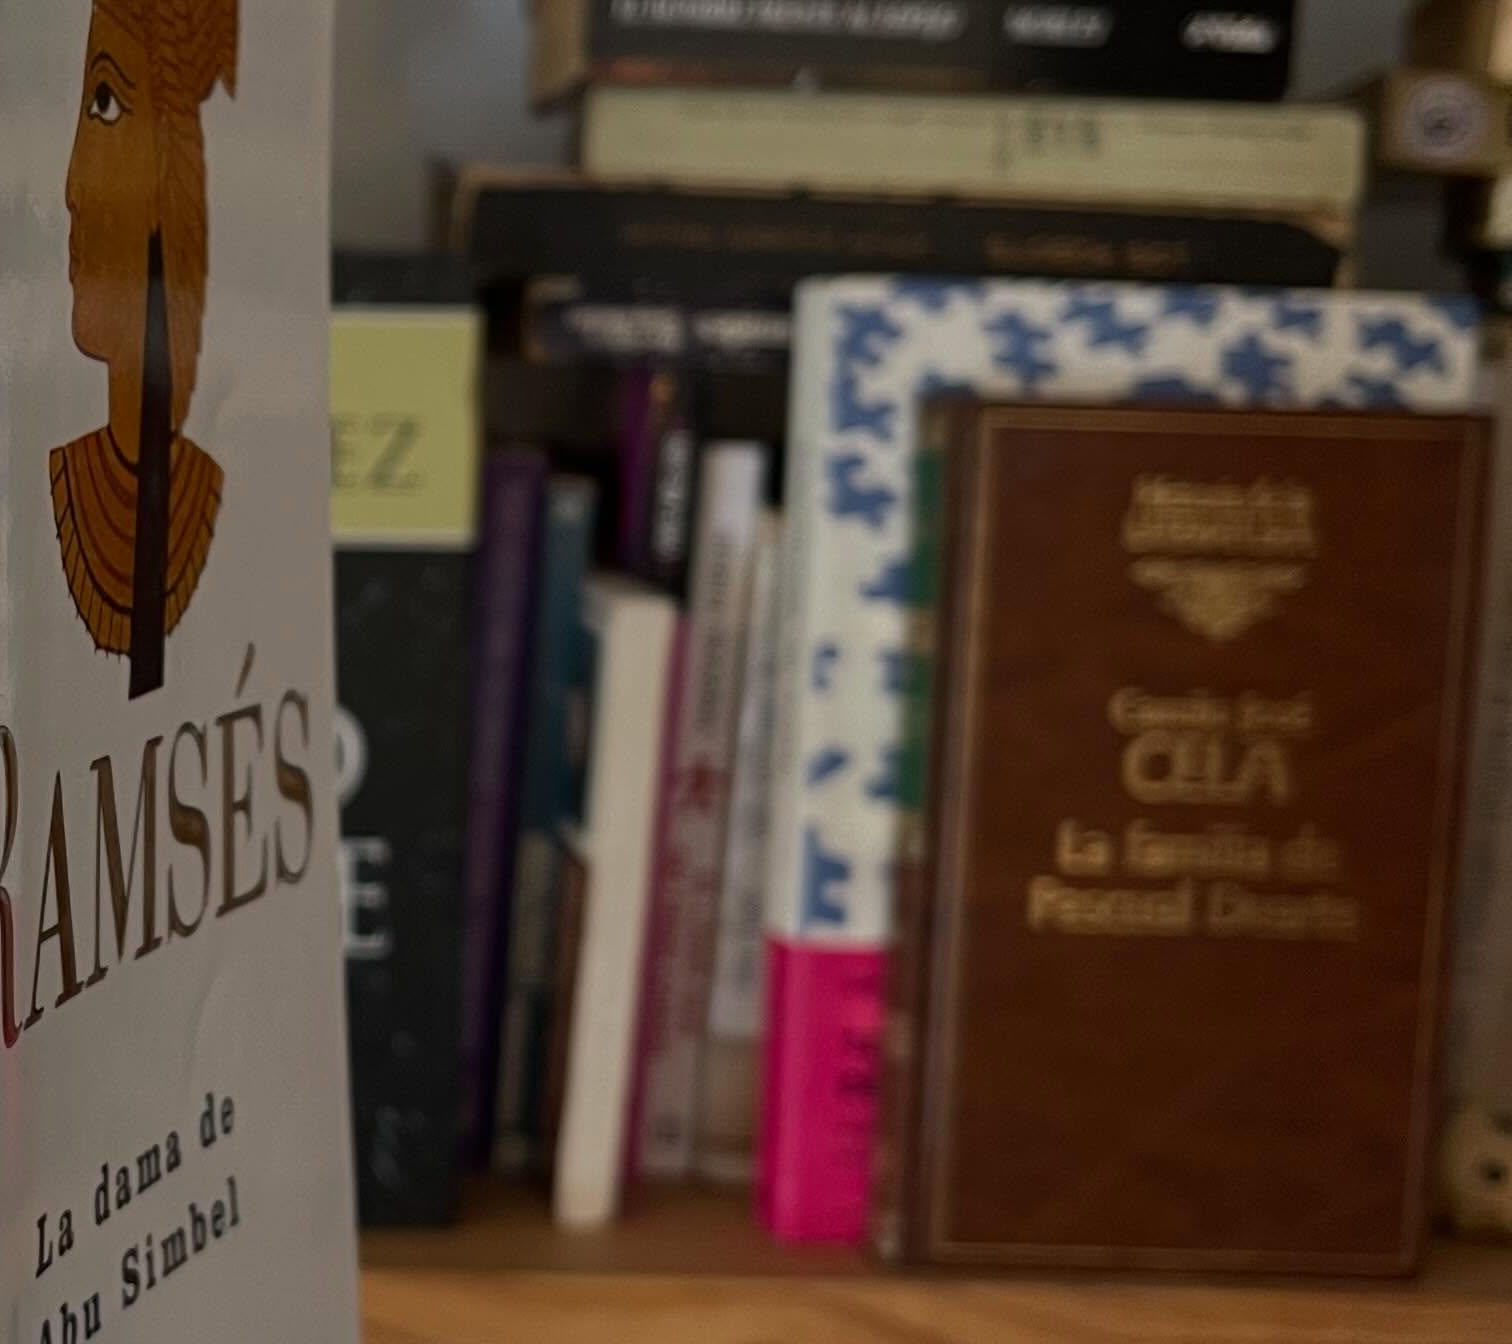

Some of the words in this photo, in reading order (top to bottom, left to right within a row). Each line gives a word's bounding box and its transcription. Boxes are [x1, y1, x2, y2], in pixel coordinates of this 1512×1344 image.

[35, 1208, 75, 1279] La
[94, 1130, 182, 1226] dama
[199, 1091, 235, 1148] de
[121, 1175, 240, 1309] Simbel
